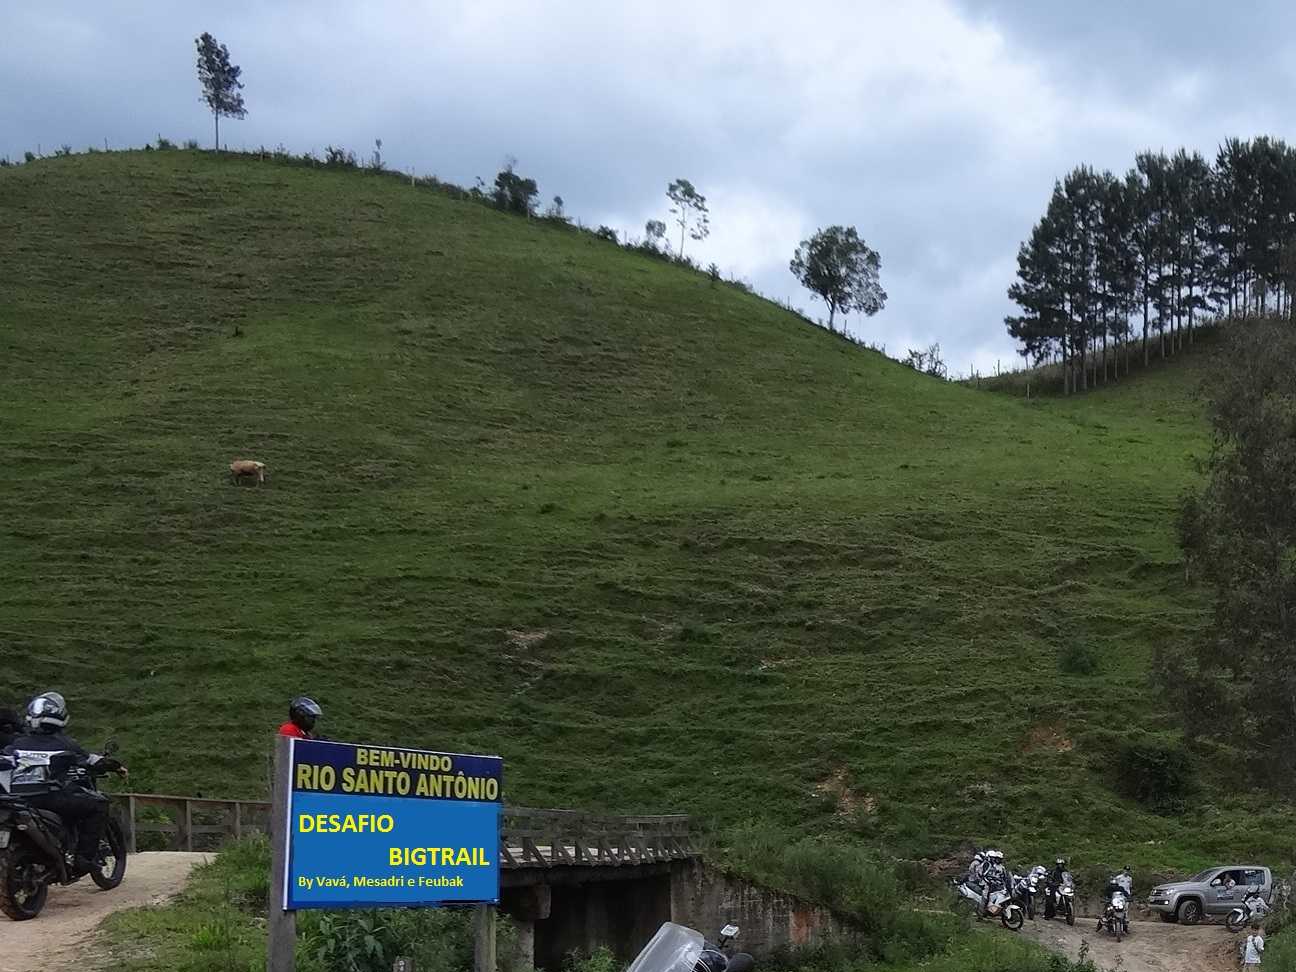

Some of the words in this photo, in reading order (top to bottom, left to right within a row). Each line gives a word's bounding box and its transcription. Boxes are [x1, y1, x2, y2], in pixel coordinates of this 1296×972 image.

[356, 748, 453, 772] BEM-VINDO
[297, 763, 336, 791] RIO
[342, 768, 411, 796] SANTO
[416, 771, 499, 801] ANTÔNIO
